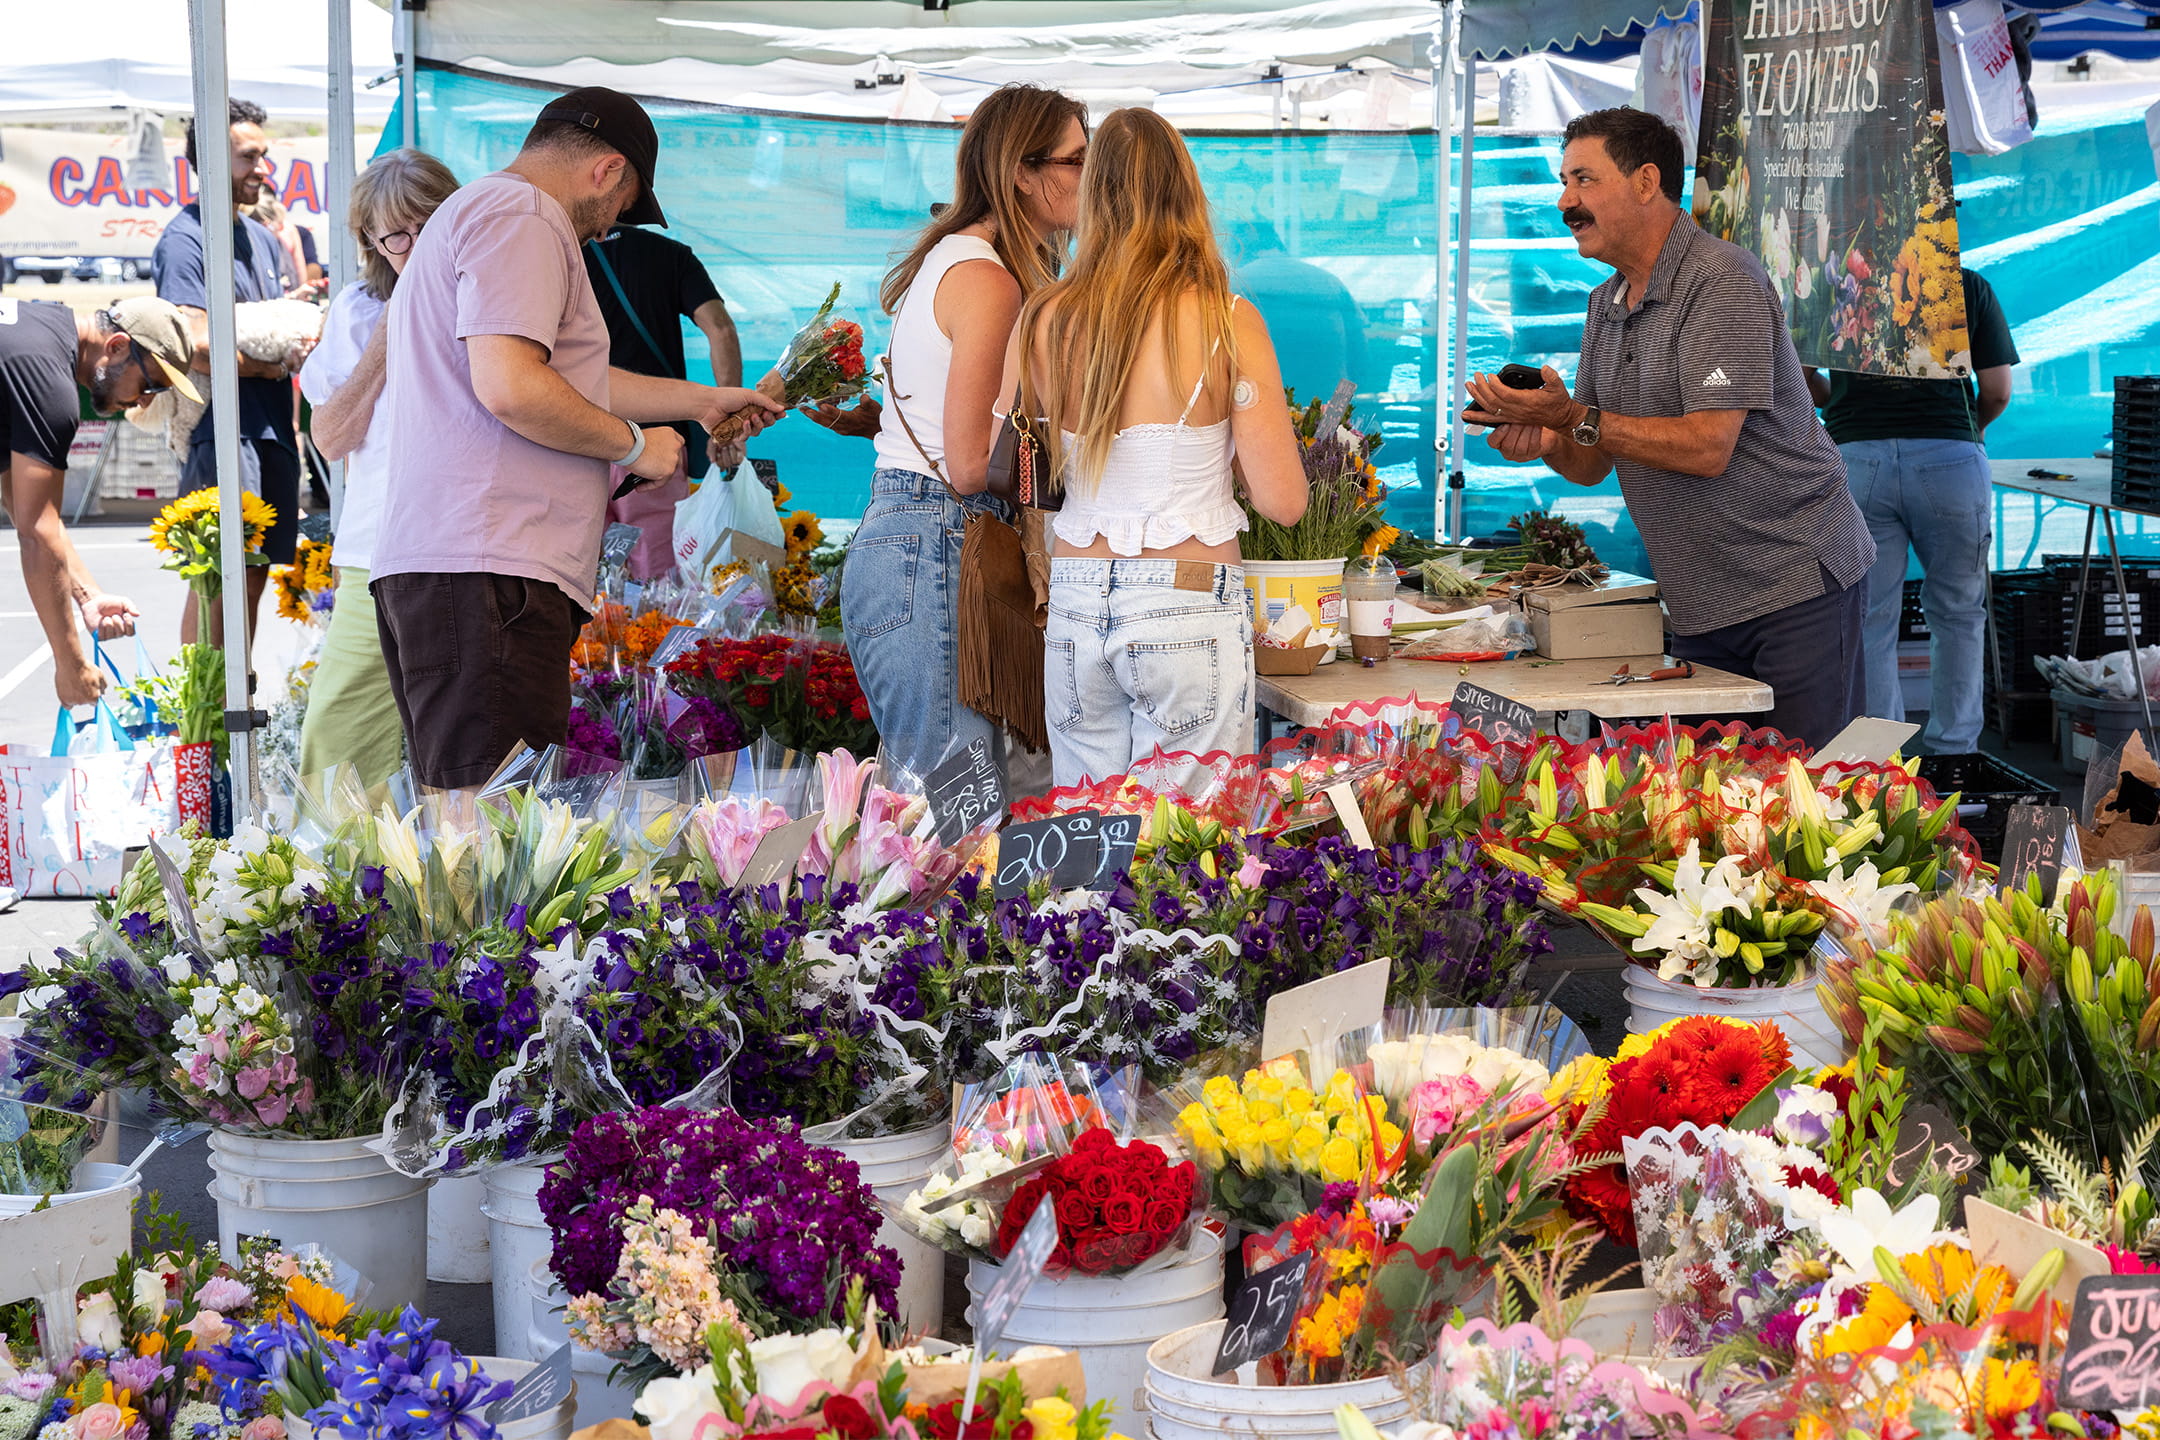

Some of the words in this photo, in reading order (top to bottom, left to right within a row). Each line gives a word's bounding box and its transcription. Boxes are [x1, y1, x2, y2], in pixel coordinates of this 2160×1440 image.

[1740, 39, 1880, 117] FLOWERS
[1763, 156, 1791, 184] Special
[1791, 156, 1813, 178] Orers
[1813, 156, 1845, 178] Available
[1784, 186, 1825, 219] Wedings
[100, 218, 163, 238] STR
[678, 536, 698, 560] YOU
[216, 783, 229, 835] Calimax
